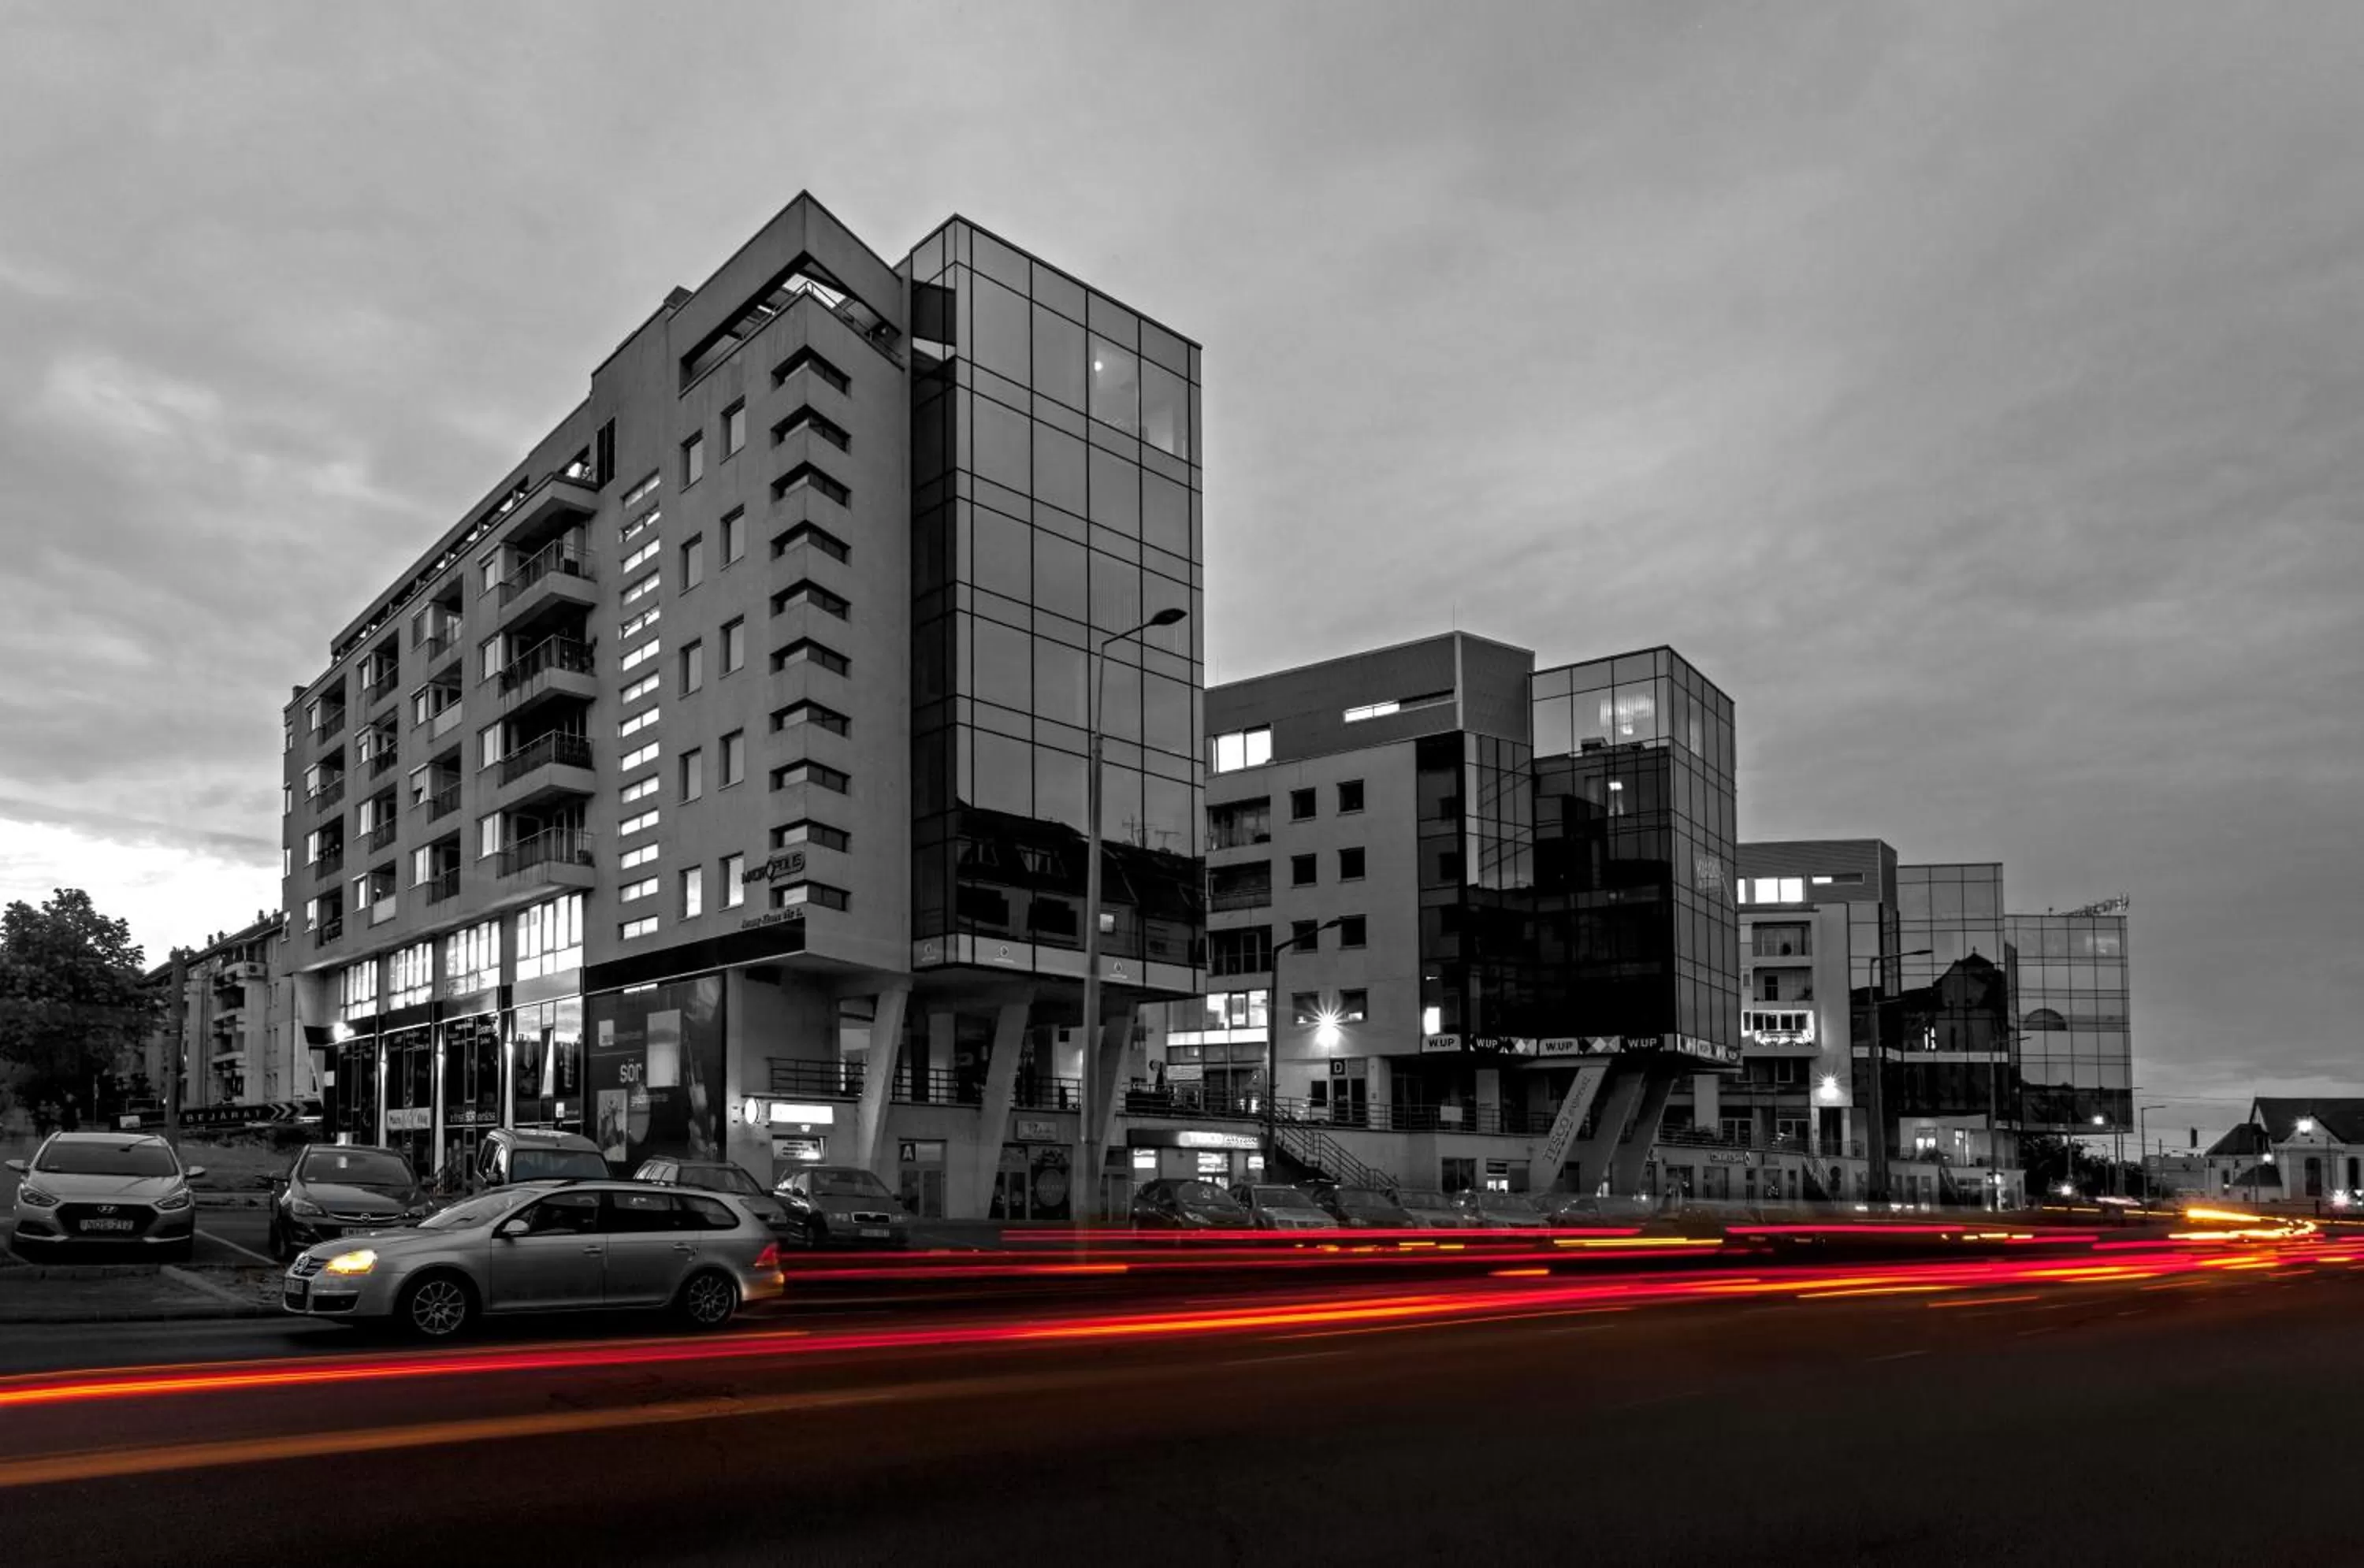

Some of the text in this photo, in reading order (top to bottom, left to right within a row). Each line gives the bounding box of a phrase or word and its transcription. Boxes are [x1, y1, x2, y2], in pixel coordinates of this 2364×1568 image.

[619, 1059, 643, 1083] sör
[1334, 1061, 1343, 1072] D
[902, 1145, 914, 1161] A
